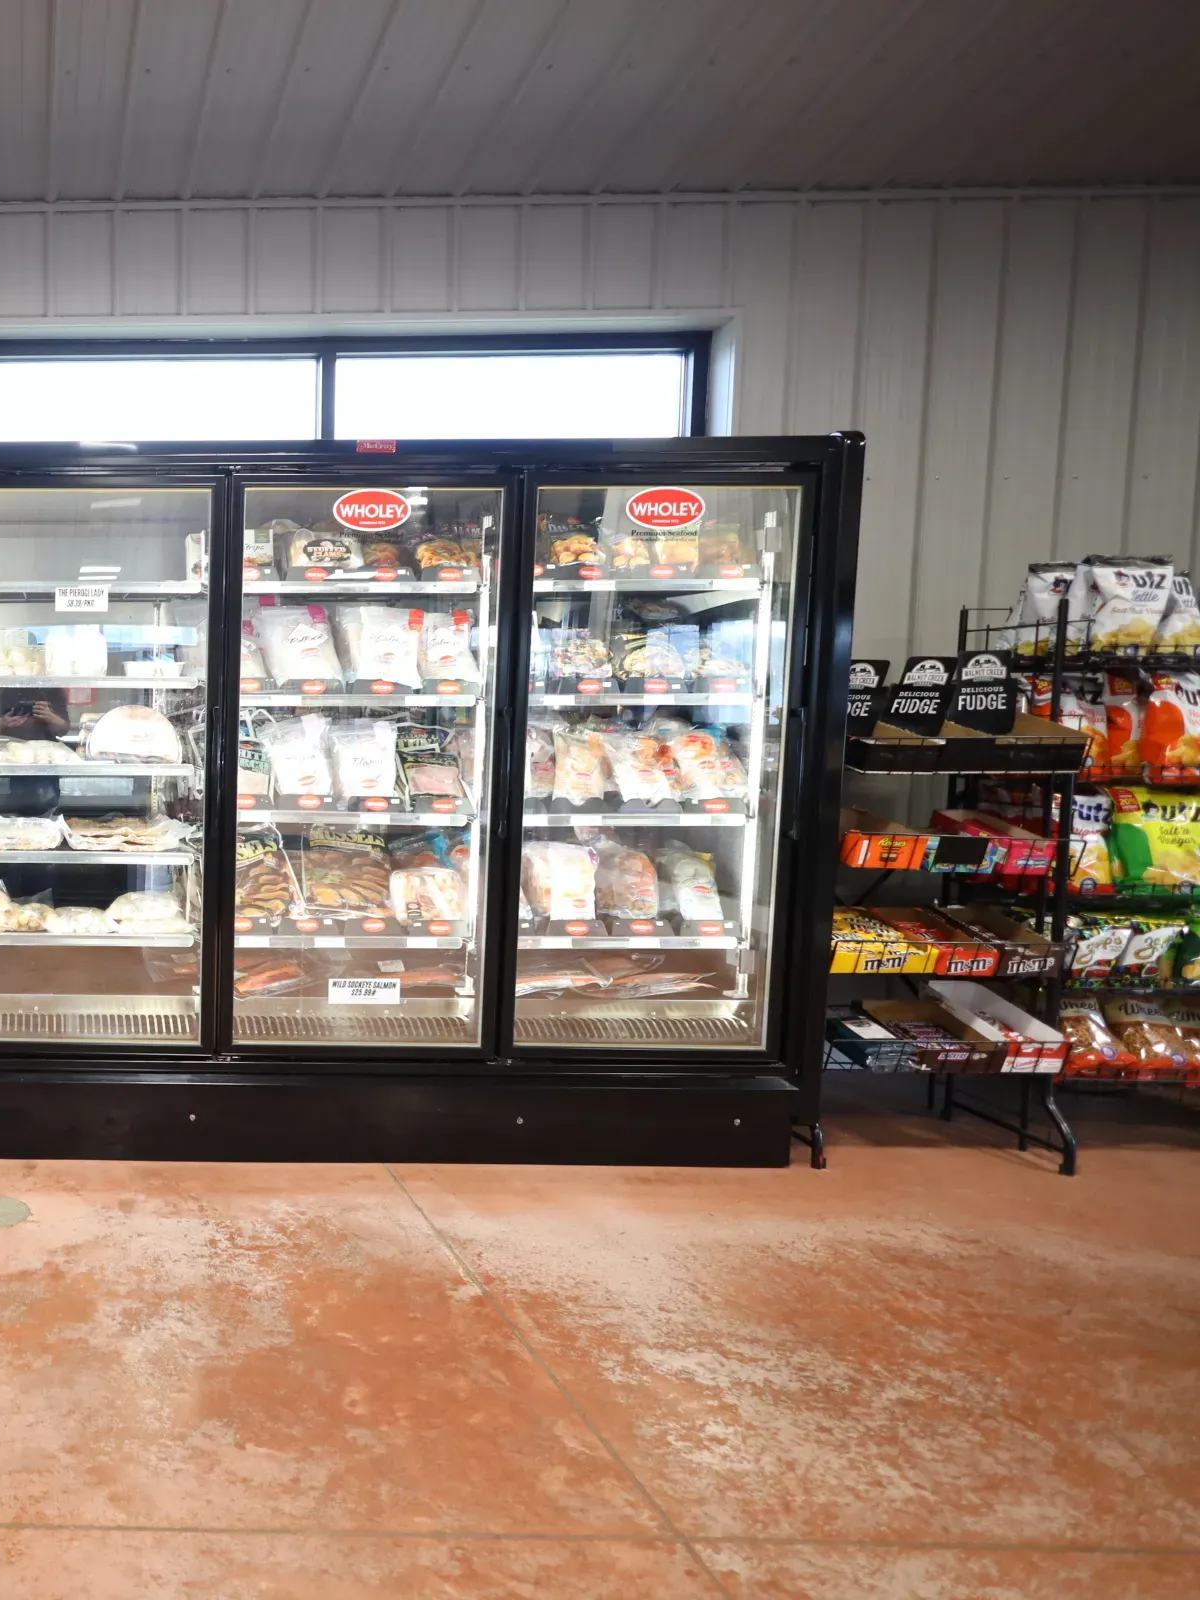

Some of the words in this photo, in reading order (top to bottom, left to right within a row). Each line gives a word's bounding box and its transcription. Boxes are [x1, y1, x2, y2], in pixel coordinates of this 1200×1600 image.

[340, 504, 405, 518] WHOLEY
[632, 502, 699, 516] WHOLEY
[58, 589, 68, 597] THE
[91, 589, 104, 597] LADY
[986, 668, 1004, 676] CREEK
[858, 677, 875, 685] CREEK
[929, 674, 945, 683] CREEK
[891, 699, 941, 714] FUDGE
[958, 694, 1007, 711] FUDGE
[1159, 827, 1180, 835] Salt
[332, 980, 347, 988] WILD
[347, 980, 372, 988] SOCKEYE
[373, 981, 397, 989] SALMON
